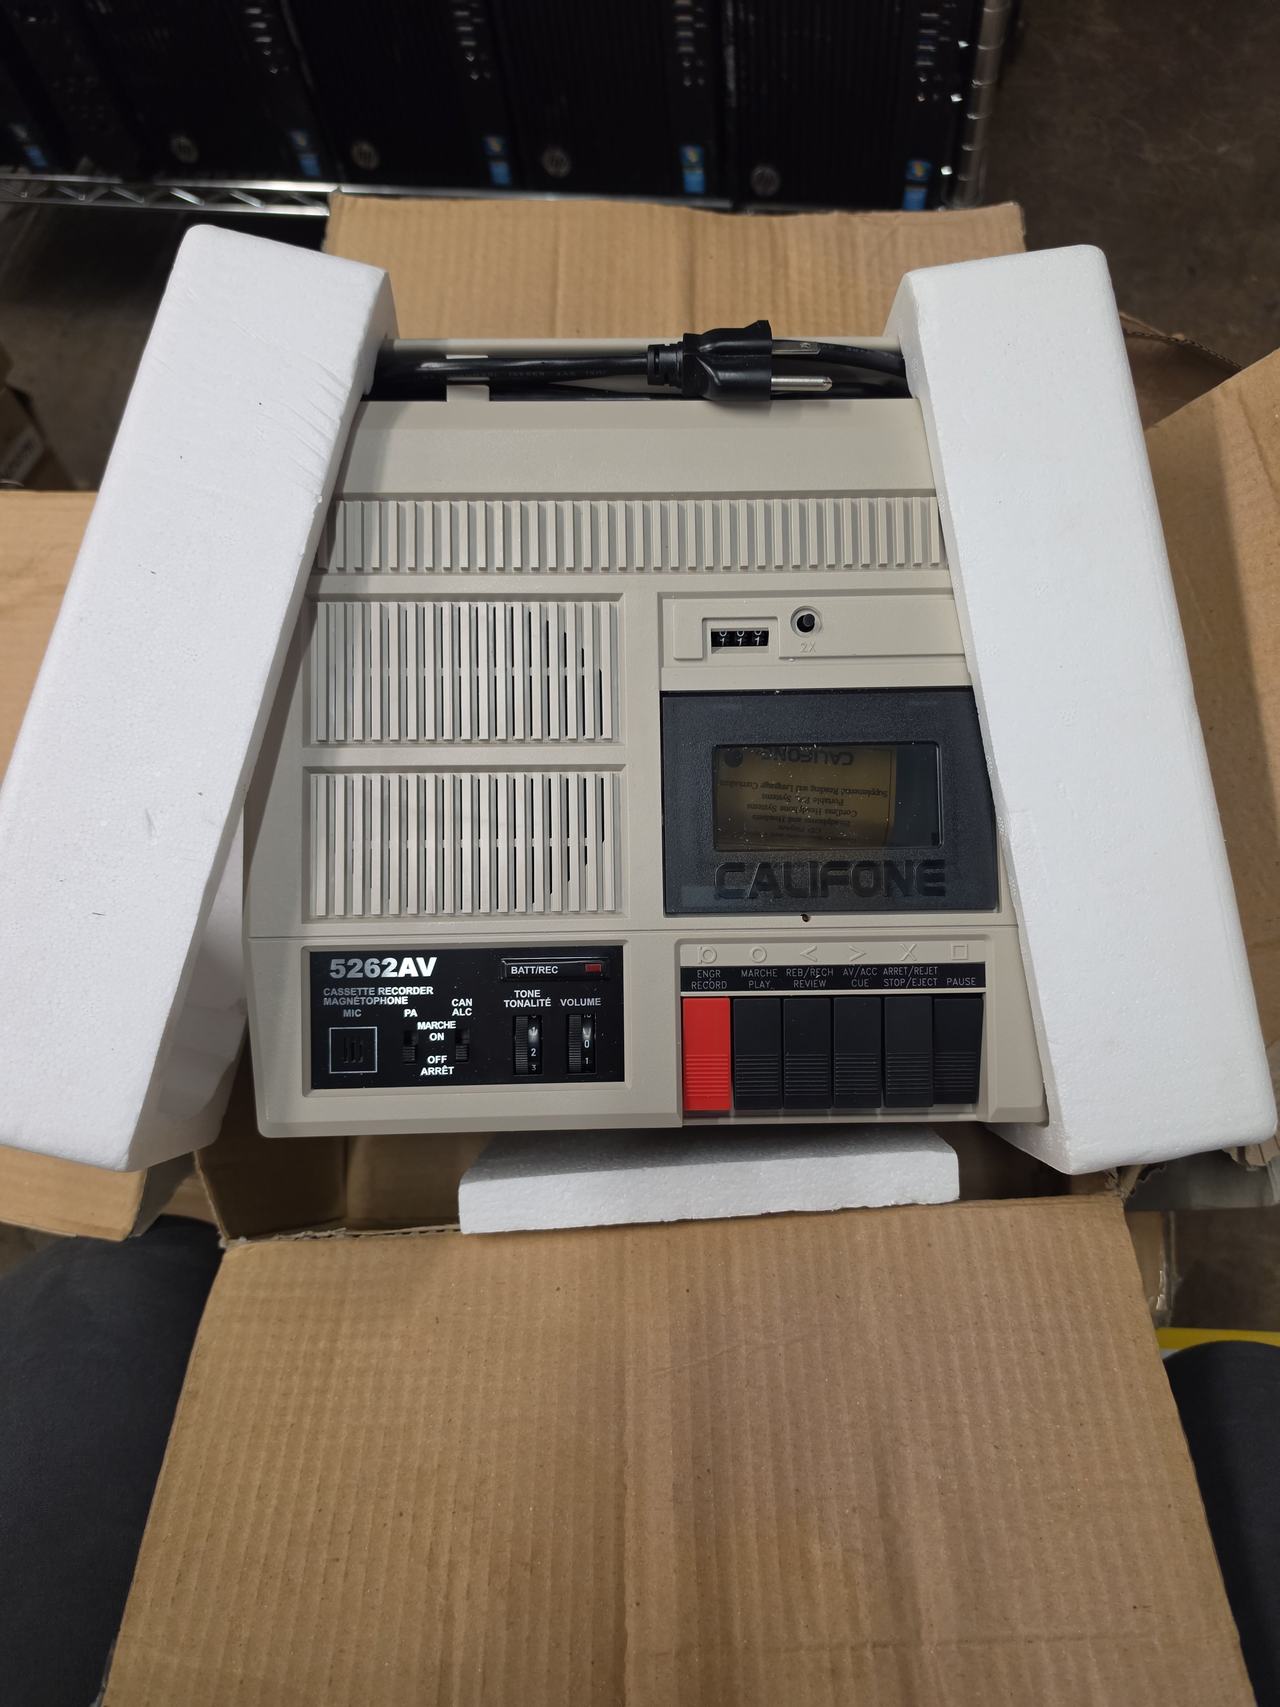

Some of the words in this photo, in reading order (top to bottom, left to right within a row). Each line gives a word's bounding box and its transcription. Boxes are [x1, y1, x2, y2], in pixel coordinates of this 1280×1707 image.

[813, 797, 844, 806] Portable
[824, 808, 857, 817] Cordless
[713, 859, 946, 899] CALIFONE
[329, 956, 438, 979] 5262AV
[510, 965, 559, 975] BATT/REC
[842, 966, 878, 978] AV/ACC
[883, 966, 939, 977] ARRET/REJET
[697, 969, 721, 978] ENGR
[741, 968, 778, 977] MARCHE
[786, 967, 834, 979] REB/RECH
[691, 980, 728, 990] RECORD
[748, 980, 771, 989] PLAY
[793, 979, 827, 988] REVIEW
[851, 979, 870, 988] CUE
[883, 977, 938, 989] STOP/EJECT
[946, 977, 976, 986] PAUSE
[323, 987, 375, 996] CASSETTE
[378, 986, 434, 996] RECORDER
[513, 989, 541, 998] TONE
[323, 995, 409, 1006] MAGNÉTOPHONE
[451, 998, 473, 1007] CAN
[503, 997, 552, 1008] TONALITÉ
[560, 998, 602, 1007] VOLUME
[343, 1009, 362, 1018] MIC
[403, 1008, 418, 1018] PA
[451, 1007, 473, 1016] ALC
[417, 1020, 457, 1030] MARCHE
[429, 1032, 445, 1041] ON
[530, 1048, 537, 1057] 2
[426, 1055, 448, 1064] OFF
[420, 1065, 455, 1076] ARRÊT
